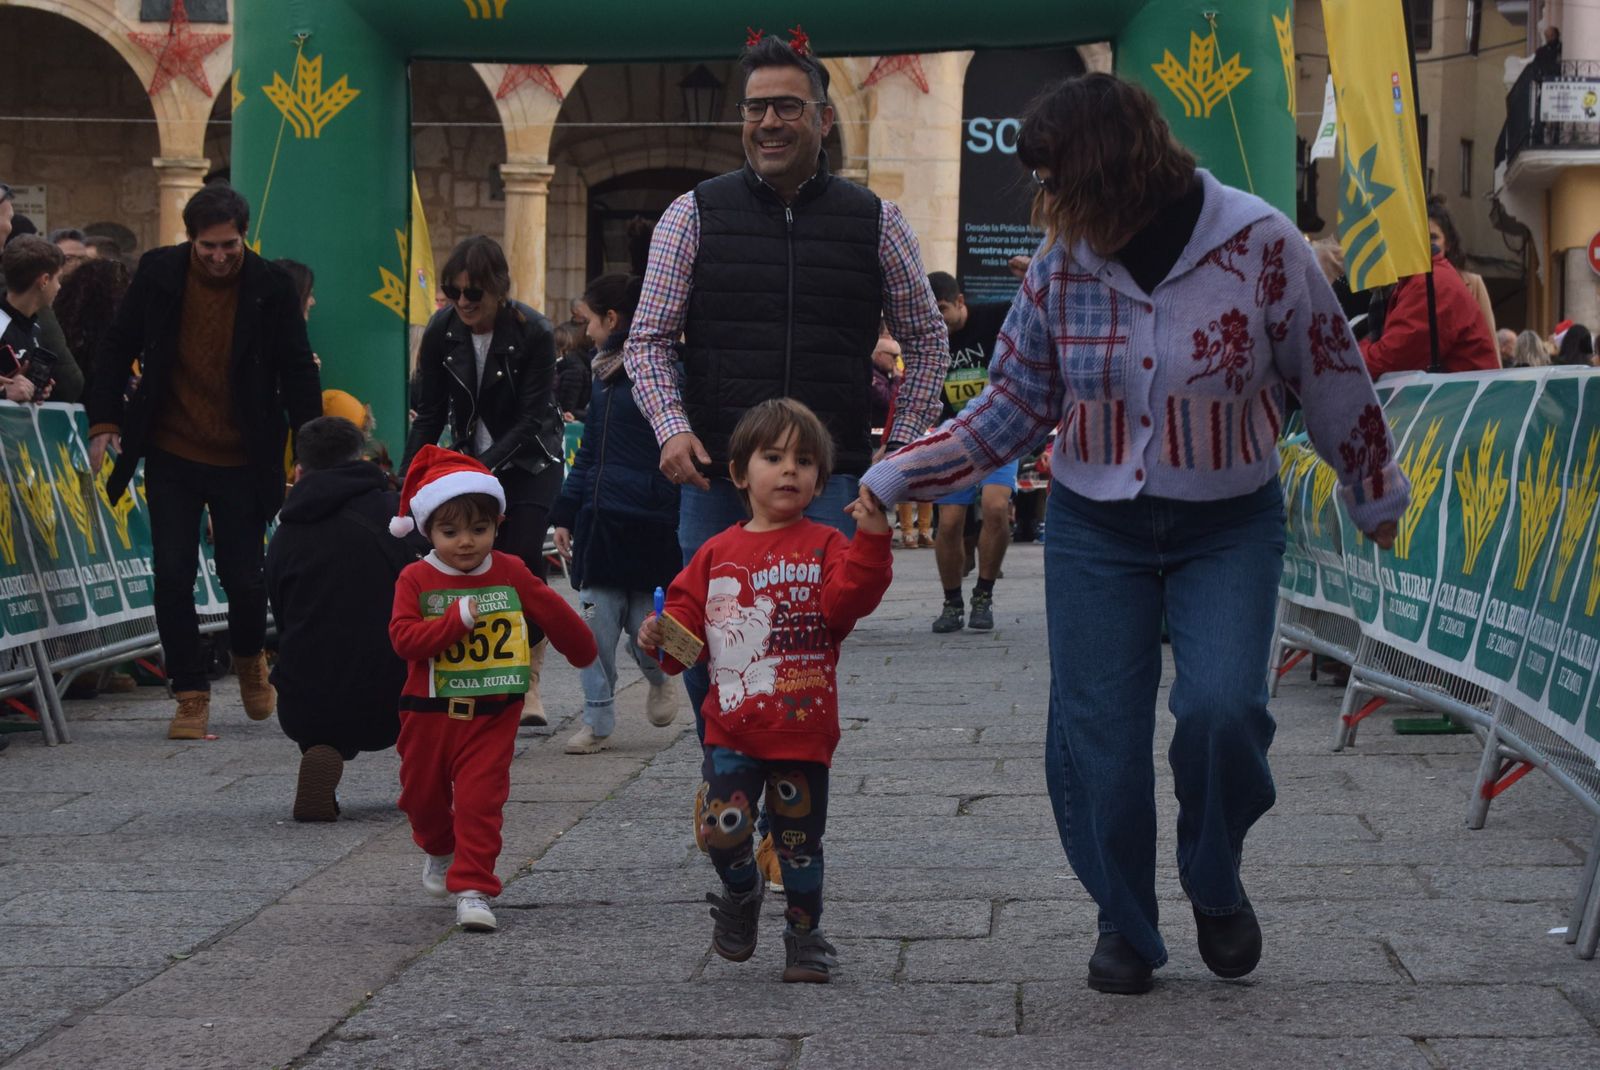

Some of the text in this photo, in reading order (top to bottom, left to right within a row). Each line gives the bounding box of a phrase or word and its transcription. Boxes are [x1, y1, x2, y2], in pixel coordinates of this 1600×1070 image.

[965, 223, 991, 232] Desde
[992, 223, 999, 232] la
[966, 235, 977, 243] de
[978, 235, 1009, 243] Zamora
[1010, 235, 1019, 243] te
[1003, 247, 1029, 256] ayuda
[982, 257, 1008, 266] más la
[788, 586, 811, 602] TO
[1398, 571, 1432, 603] RURAL
[1437, 582, 1481, 619] CAJA RURAL
[1395, 599, 1419, 621] ZAMORA
[1485, 598, 1508, 629] CAJA
[1437, 614, 1447, 631] DE
[1486, 632, 1497, 650] DE
[449, 675, 525, 689] CAJA RURAL
